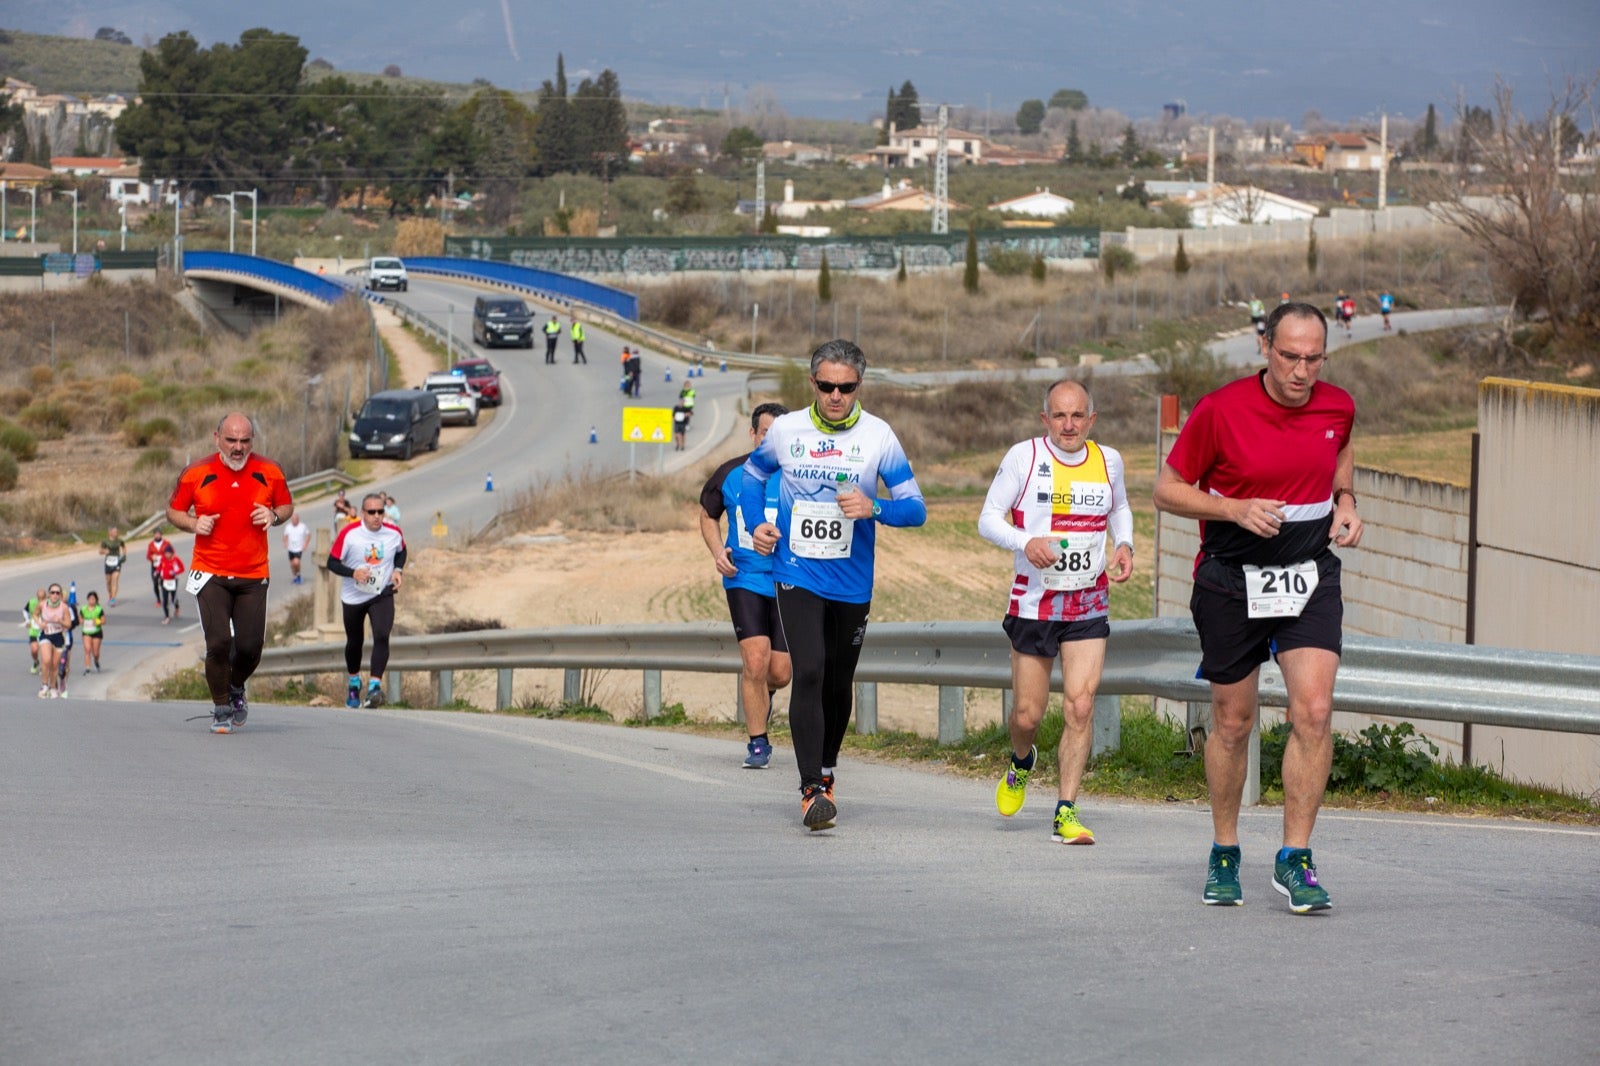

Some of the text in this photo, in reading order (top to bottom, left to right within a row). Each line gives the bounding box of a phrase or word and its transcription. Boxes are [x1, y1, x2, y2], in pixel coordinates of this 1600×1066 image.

[817, 439, 835, 452] 35
[792, 468, 860, 484] MARACNA
[801, 518, 842, 541] 668
[1054, 550, 1091, 572] 383
[1260, 570, 1308, 594] 210
